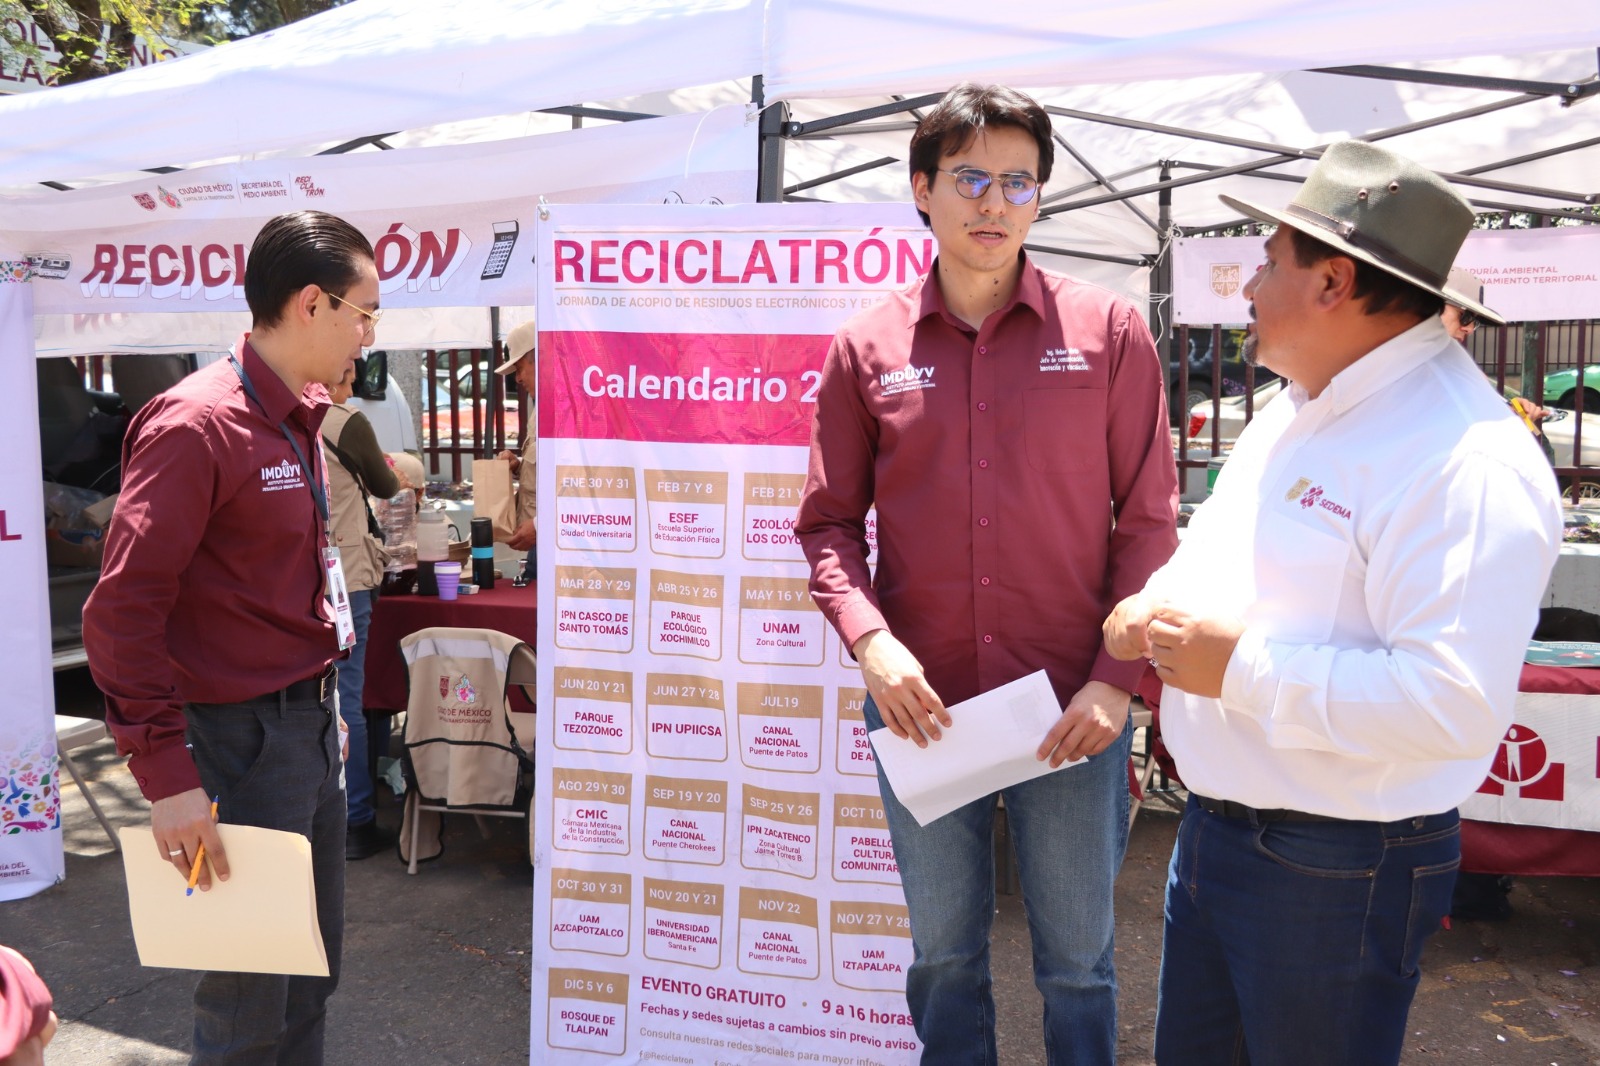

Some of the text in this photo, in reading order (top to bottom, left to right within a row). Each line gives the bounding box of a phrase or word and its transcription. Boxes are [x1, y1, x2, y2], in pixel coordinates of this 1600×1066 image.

[178, 187, 203, 195] CIUDAD
[214, 183, 233, 192] MÉXICO
[241, 180, 272, 189] SECRETARÍA
[261, 189, 287, 197] AMBIENTE
[554, 227, 933, 284] RECICLATRÓN
[1501, 266, 1558, 275] AMBIENTAL
[1533, 274, 1598, 284] TERRITORIAL
[556, 296, 857, 309] JORNADA DE ACOPIO DE RESIDUOS ELECTRÓNICOS Y
[582, 365, 788, 403] Calendario
[563, 477, 629, 489] ENE 30 Y 31
[657, 482, 713, 494] FEB 7 Y 8
[752, 487, 775, 498] FEB
[779, 488, 792, 498] 21
[1319, 499, 1351, 520] SEDEMA
[561, 514, 632, 526] UNIVERSUM
[669, 513, 699, 524] ESEF
[561, 529, 632, 539] Ciudad Universitaria
[658, 523, 715, 535] Escuela Superior
[664, 532, 696, 543] Educación
[697, 534, 720, 544] Física
[746, 533, 766, 544] LOS
[560, 579, 631, 592] MAR 28 Y 29
[657, 583, 718, 599] ABR 25 Y 26
[746, 590, 804, 601] MAY 16 Y
[561, 611, 629, 623] IPN CASCO DE
[671, 611, 701, 623] PARQUE
[559, 623, 629, 636] SANTO TOMÁS
[663, 621, 707, 636] ECOLÓGICO
[763, 623, 800, 634] UNAM
[660, 634, 711, 648] XOCHIMILCO
[756, 639, 806, 648] Zona Cultural
[560, 678, 626, 694] JUN 20 Y 21
[653, 685, 720, 700] JUN 27 Y 28
[459, 707, 492, 717] MÉXICO
[574, 712, 614, 724] PARQUE
[563, 724, 623, 737] TEZOZOMOC
[652, 723, 722, 737] IPN UPIICSA
[762, 725, 793, 736] CANAL
[754, 737, 801, 748] NACIONAL
[851, 751, 864, 761] DE
[576, 809, 609, 820] CMIC
[840, 807, 883, 820] OCT 10
[562, 819, 622, 831] Cámara Mexicana
[670, 819, 698, 830] CANAL
[662, 830, 706, 842] NACIONAL
[747, 825, 811, 844] IPN ZACATENCO
[652, 840, 716, 852] Puente Cherokees
[758, 899, 801, 914] NOV 22
[579, 914, 600, 924] UAM
[837, 913, 911, 928] NOV 27 Y 28
[553, 922, 624, 938] AZCAPOTZALCO
[656, 918, 710, 933] UNIVERSIDAD
[648, 928, 718, 945] IBEROAMERICANA
[762, 931, 793, 942] CANAL
[668, 941, 697, 952] Santa Fe
[755, 942, 801, 954] NACIONAL
[862, 949, 885, 959] UAM
[842, 961, 902, 974] IZTAPALAPA
[564, 978, 614, 994] DIC 5 Y 6
[641, 976, 787, 1008] EVENTO GRATUITO
[561, 1011, 616, 1025] BOSQUE DE
[821, 1000, 914, 1027] 9 a 16 horas
[565, 1023, 609, 1038] TLALPAN
[641, 1002, 917, 1051] Fechas y sedes sujetas a cambios sin previo aviso
[640, 1027, 682, 1040] Consulta
[683, 1031, 725, 1048] nuestras
[728, 1037, 753, 1052] redes
[755, 1041, 795, 1059] sociales
[797, 1050, 820, 1065] para
